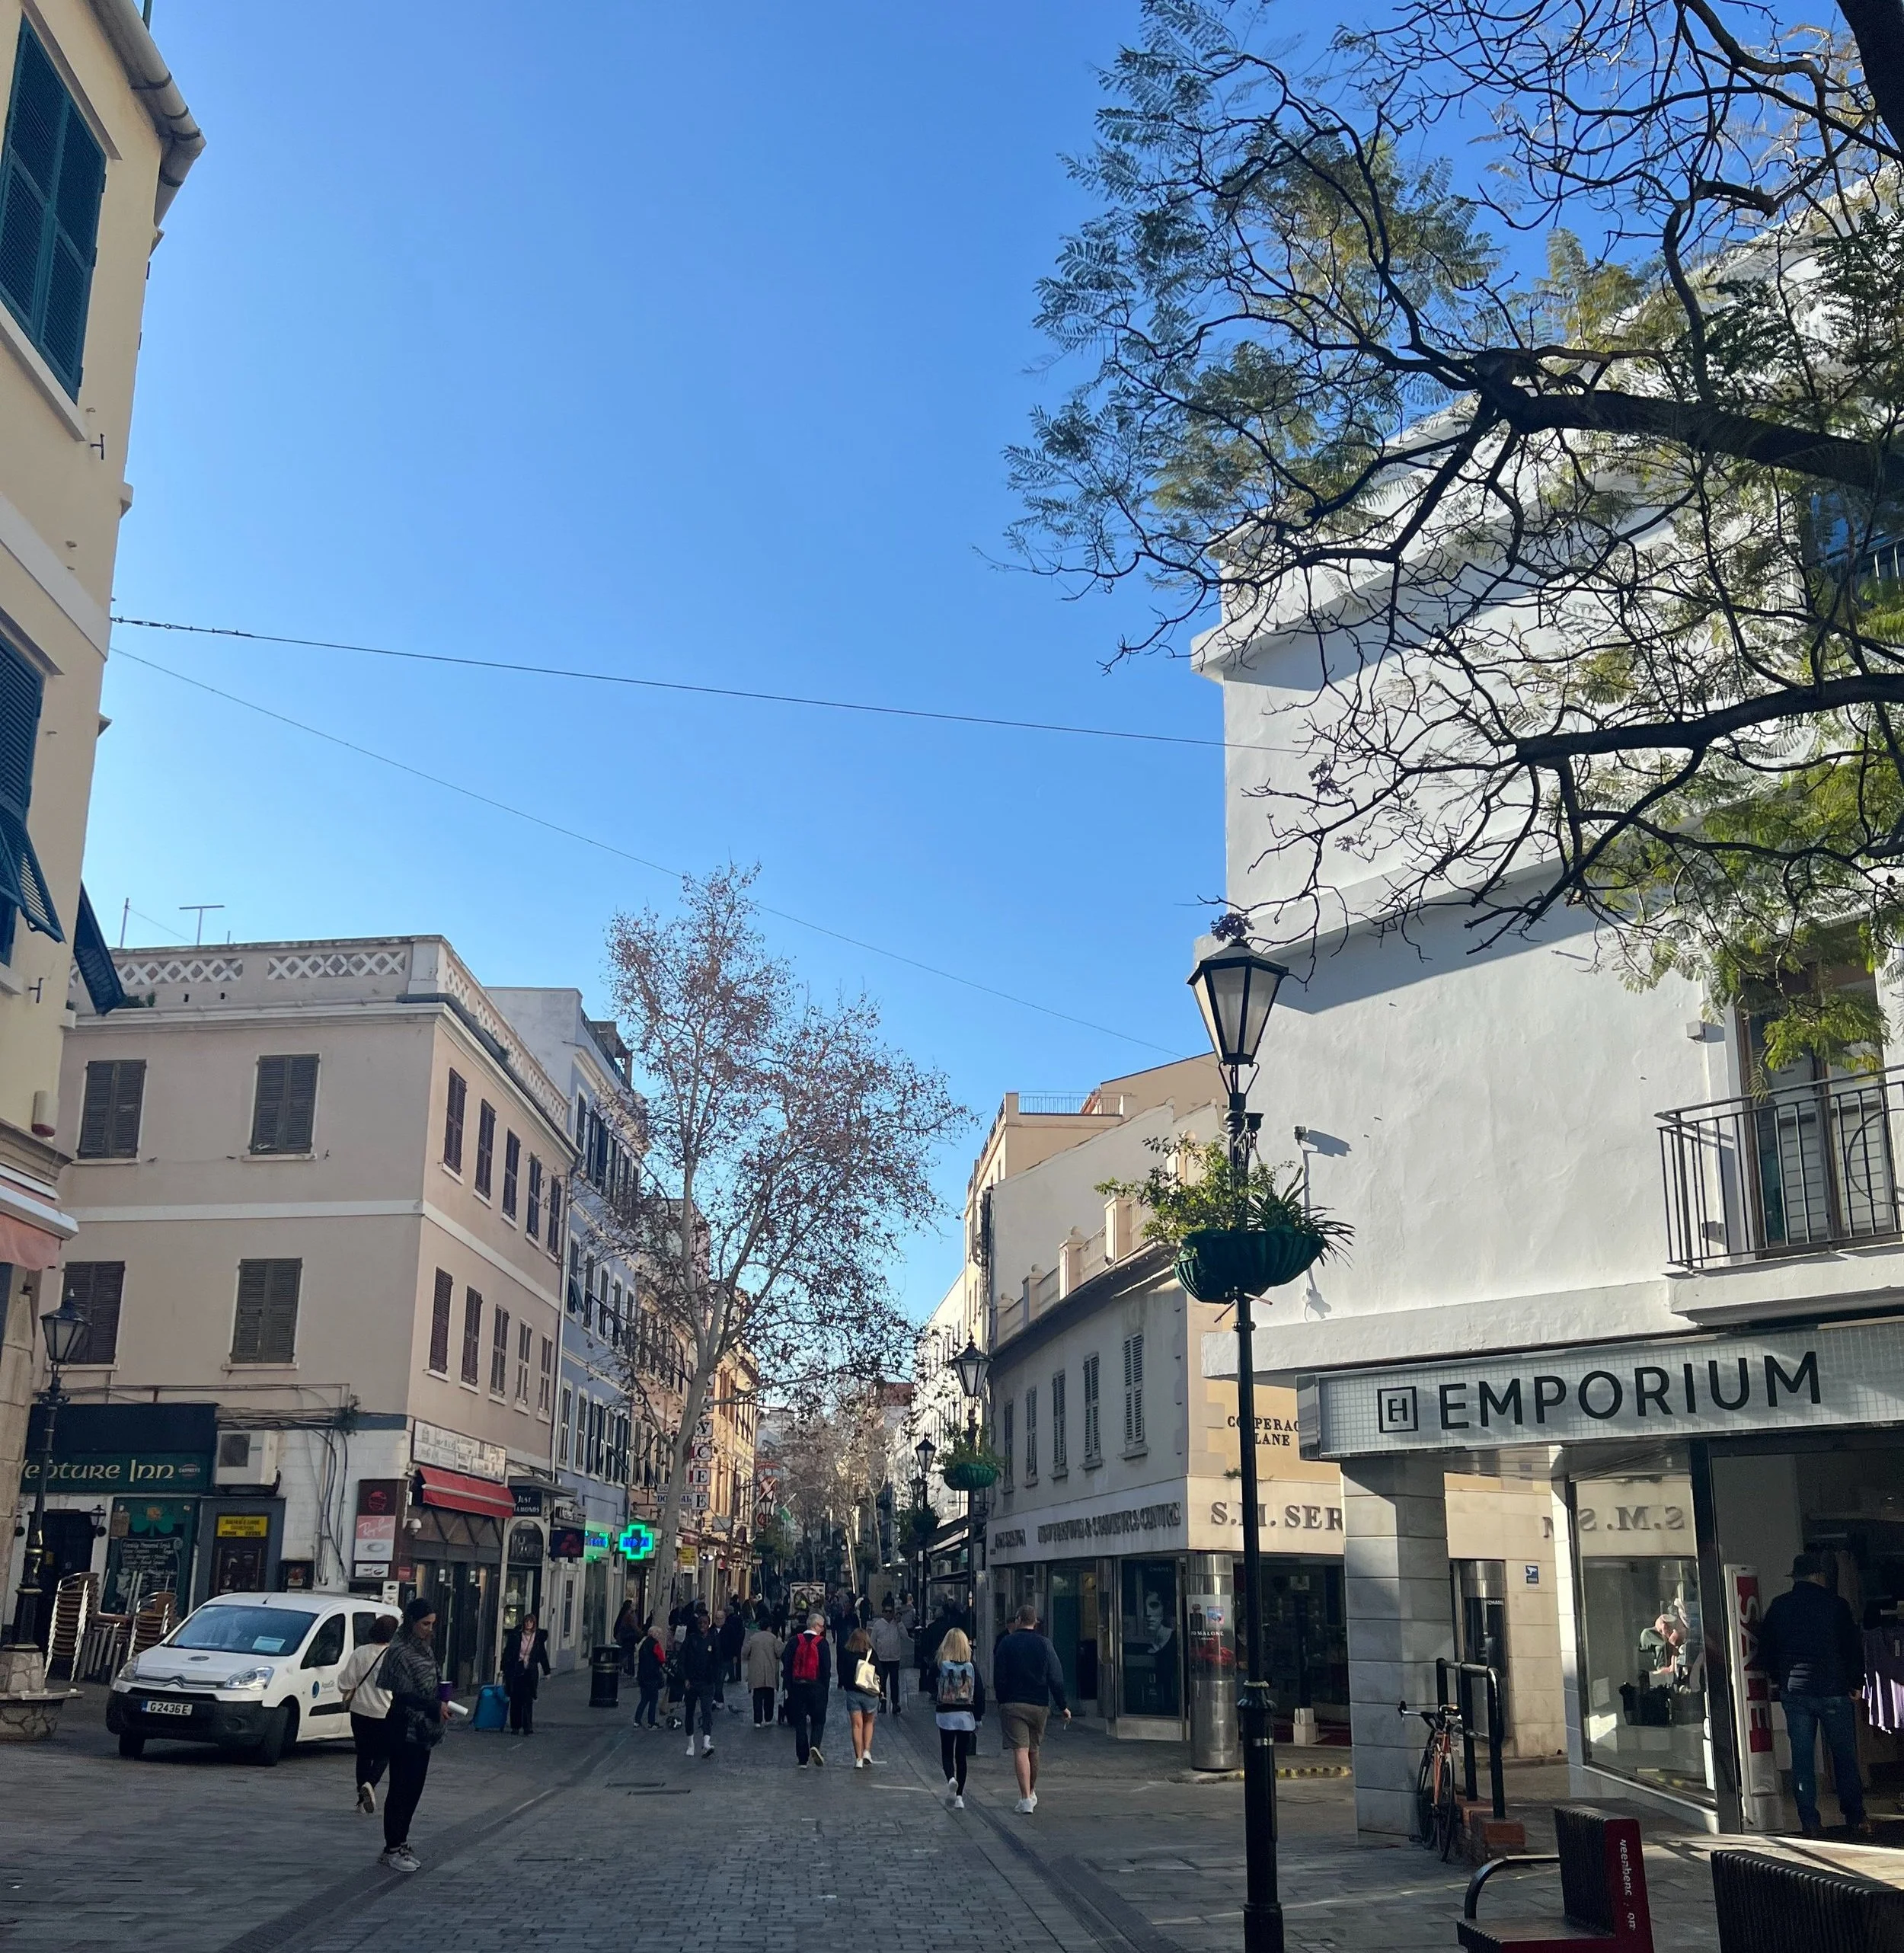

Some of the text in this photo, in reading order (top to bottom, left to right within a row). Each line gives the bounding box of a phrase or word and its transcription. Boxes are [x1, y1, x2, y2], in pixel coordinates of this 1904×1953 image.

[1438, 1351, 1821, 1430] EMPORIUM
[1227, 1415, 1299, 1432] CPERA
[1254, 1433, 1290, 1446] LANE
[129, 1459, 174, 1482] Inn
[1737, 1593, 1769, 1731] SALE
